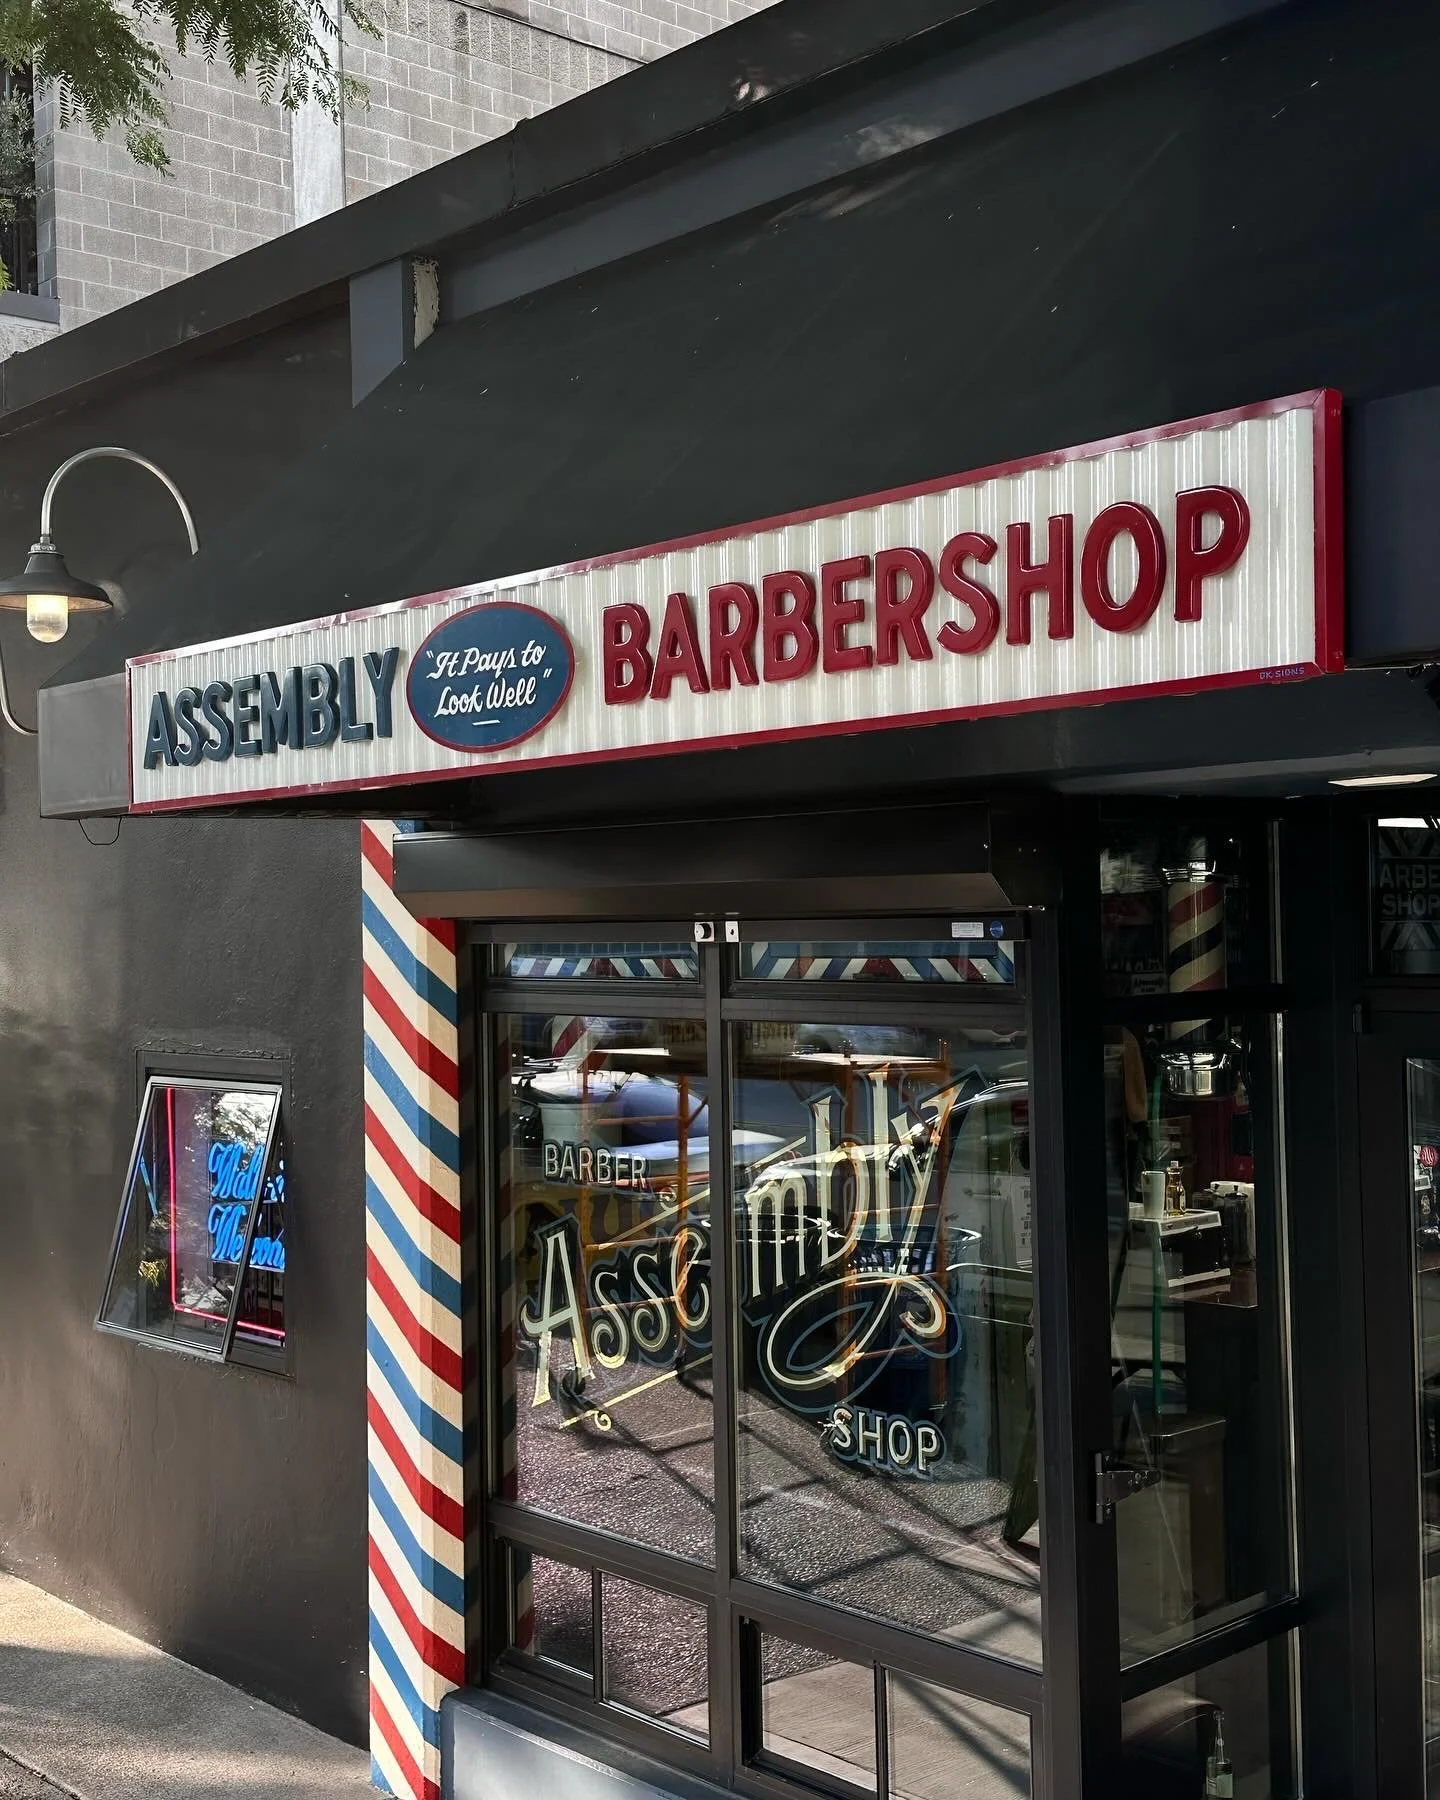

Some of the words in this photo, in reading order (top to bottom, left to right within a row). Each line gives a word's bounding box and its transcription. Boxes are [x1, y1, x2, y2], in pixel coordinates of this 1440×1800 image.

[602, 484, 1250, 706] BARBERSHOP
[457, 647, 517, 678] Pays
[521, 640, 546, 667] to
[143, 647, 400, 770] ASSEMBLY
[434, 684, 483, 717] Look
[1379, 863, 1440, 889] ARBE
[1382, 893, 1440, 917] SHOP
[544, 1142, 648, 1190] BARBER
[518, 1062, 967, 1407] Assembly
[833, 1407, 939, 1471] SHOP
